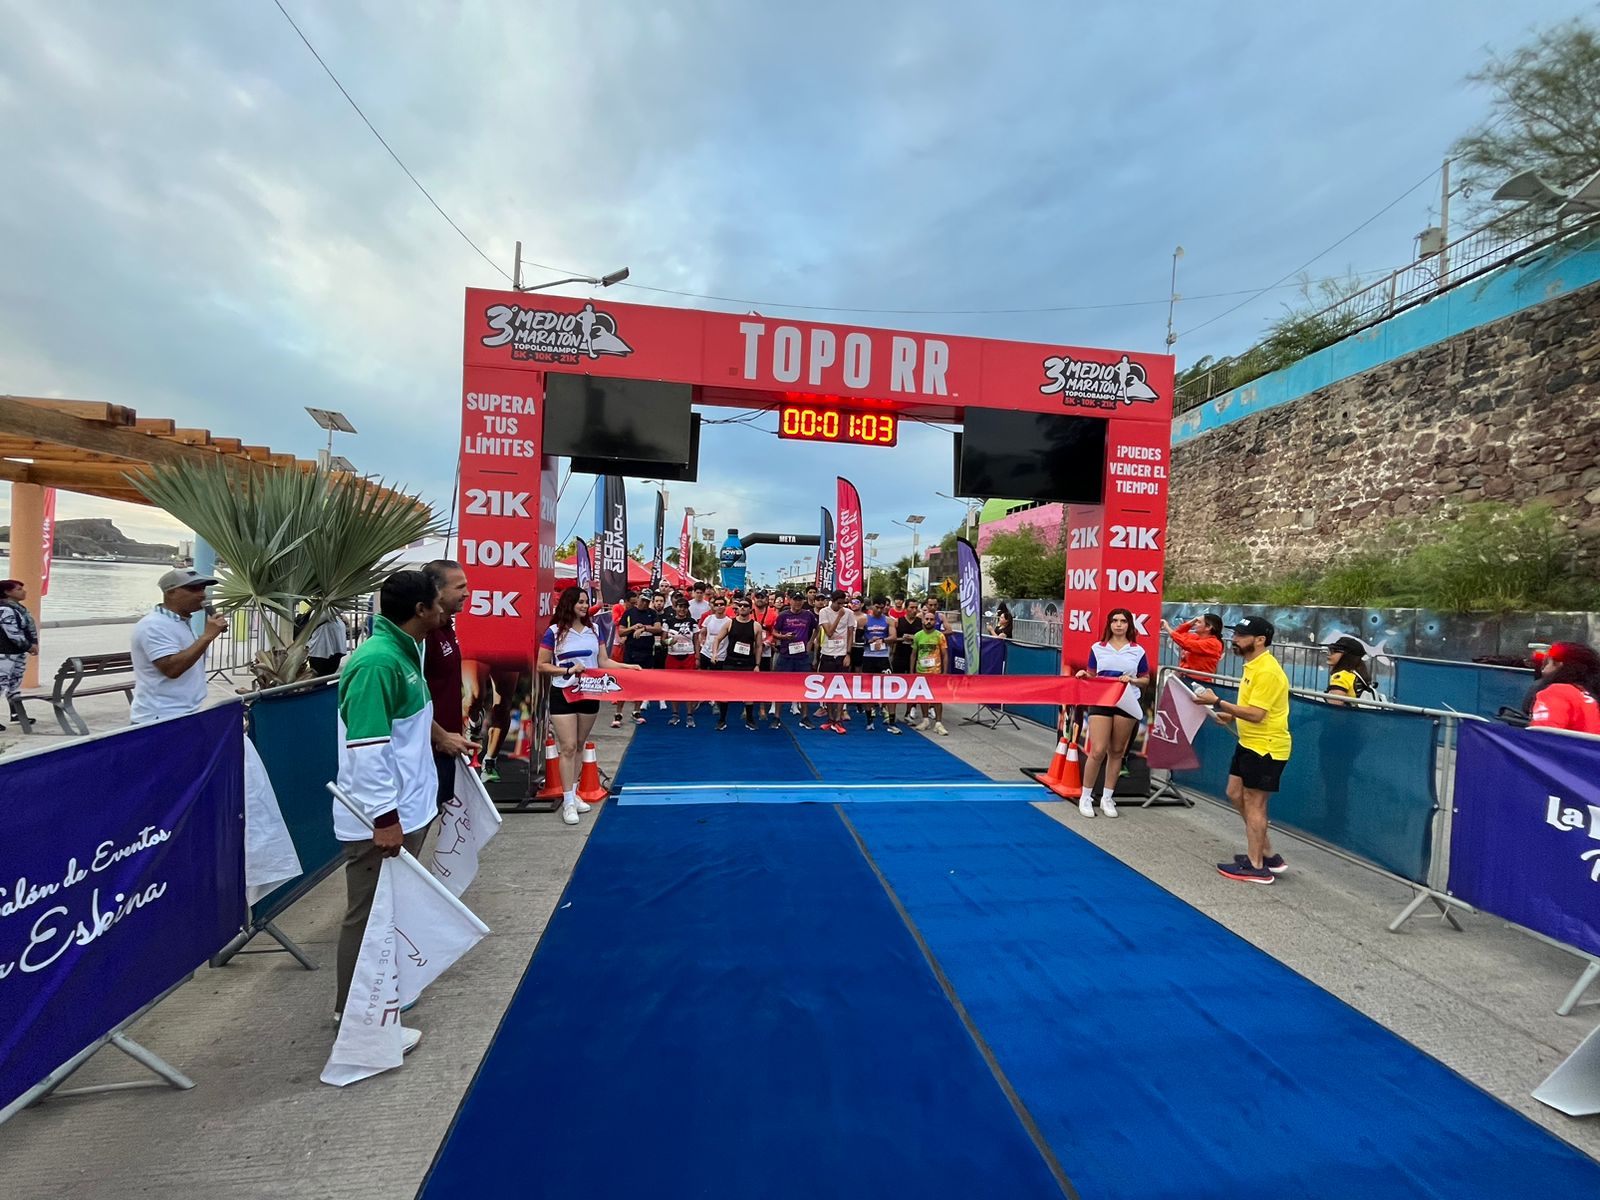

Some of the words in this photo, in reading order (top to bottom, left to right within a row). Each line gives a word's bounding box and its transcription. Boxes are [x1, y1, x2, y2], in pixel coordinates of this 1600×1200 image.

[515, 310, 576, 332] MEDIO
[514, 329, 582, 347] MARATÓN
[514, 343, 578, 354] TOPOLOBAMPO
[513, 351, 527, 359] 5K
[535, 352, 552, 361] 10K
[560, 355, 577, 363] 21K
[739, 321, 872, 389] TOPO
[1066, 362, 1115, 380] MEDIO
[1065, 390, 1116, 400] TOPOLOBAMPO
[1066, 378, 1119, 394] MARATÓN
[467, 392, 536, 415] SUPERA
[483, 415, 519, 435] TUS
[465, 432, 535, 458] LÍMITES
[1116, 444, 1162, 461] ¡PUEDES
[1109, 462, 1152, 478] VENCER
[1154, 465, 1167, 479] EL
[1115, 480, 1159, 495] TIEMPO!
[464, 488, 530, 518] 21K
[540, 496, 556, 523] 21K
[778, 535, 796, 543] META
[1070, 525, 1099, 549] 21K
[1109, 525, 1160, 550] 21K
[462, 539, 531, 568] 10K
[538, 543, 555, 569] 10K
[603, 530, 613, 571] ADE
[1067, 568, 1098, 590] 10K
[1106, 569, 1159, 593] 10K
[469, 590, 520, 617] 5K
[538, 592, 551, 617] 5K
[1068, 609, 1092, 632] 5K
[1132, 613, 1149, 636] K
[803, 674, 934, 700] SALIDA
[63, 858, 89, 888] de
[91, 825, 172, 873] Eventos
[19, 881, 167, 973] Eskina
[378, 949, 391, 965] DE
[362, 971, 385, 1026] TRABAJO
